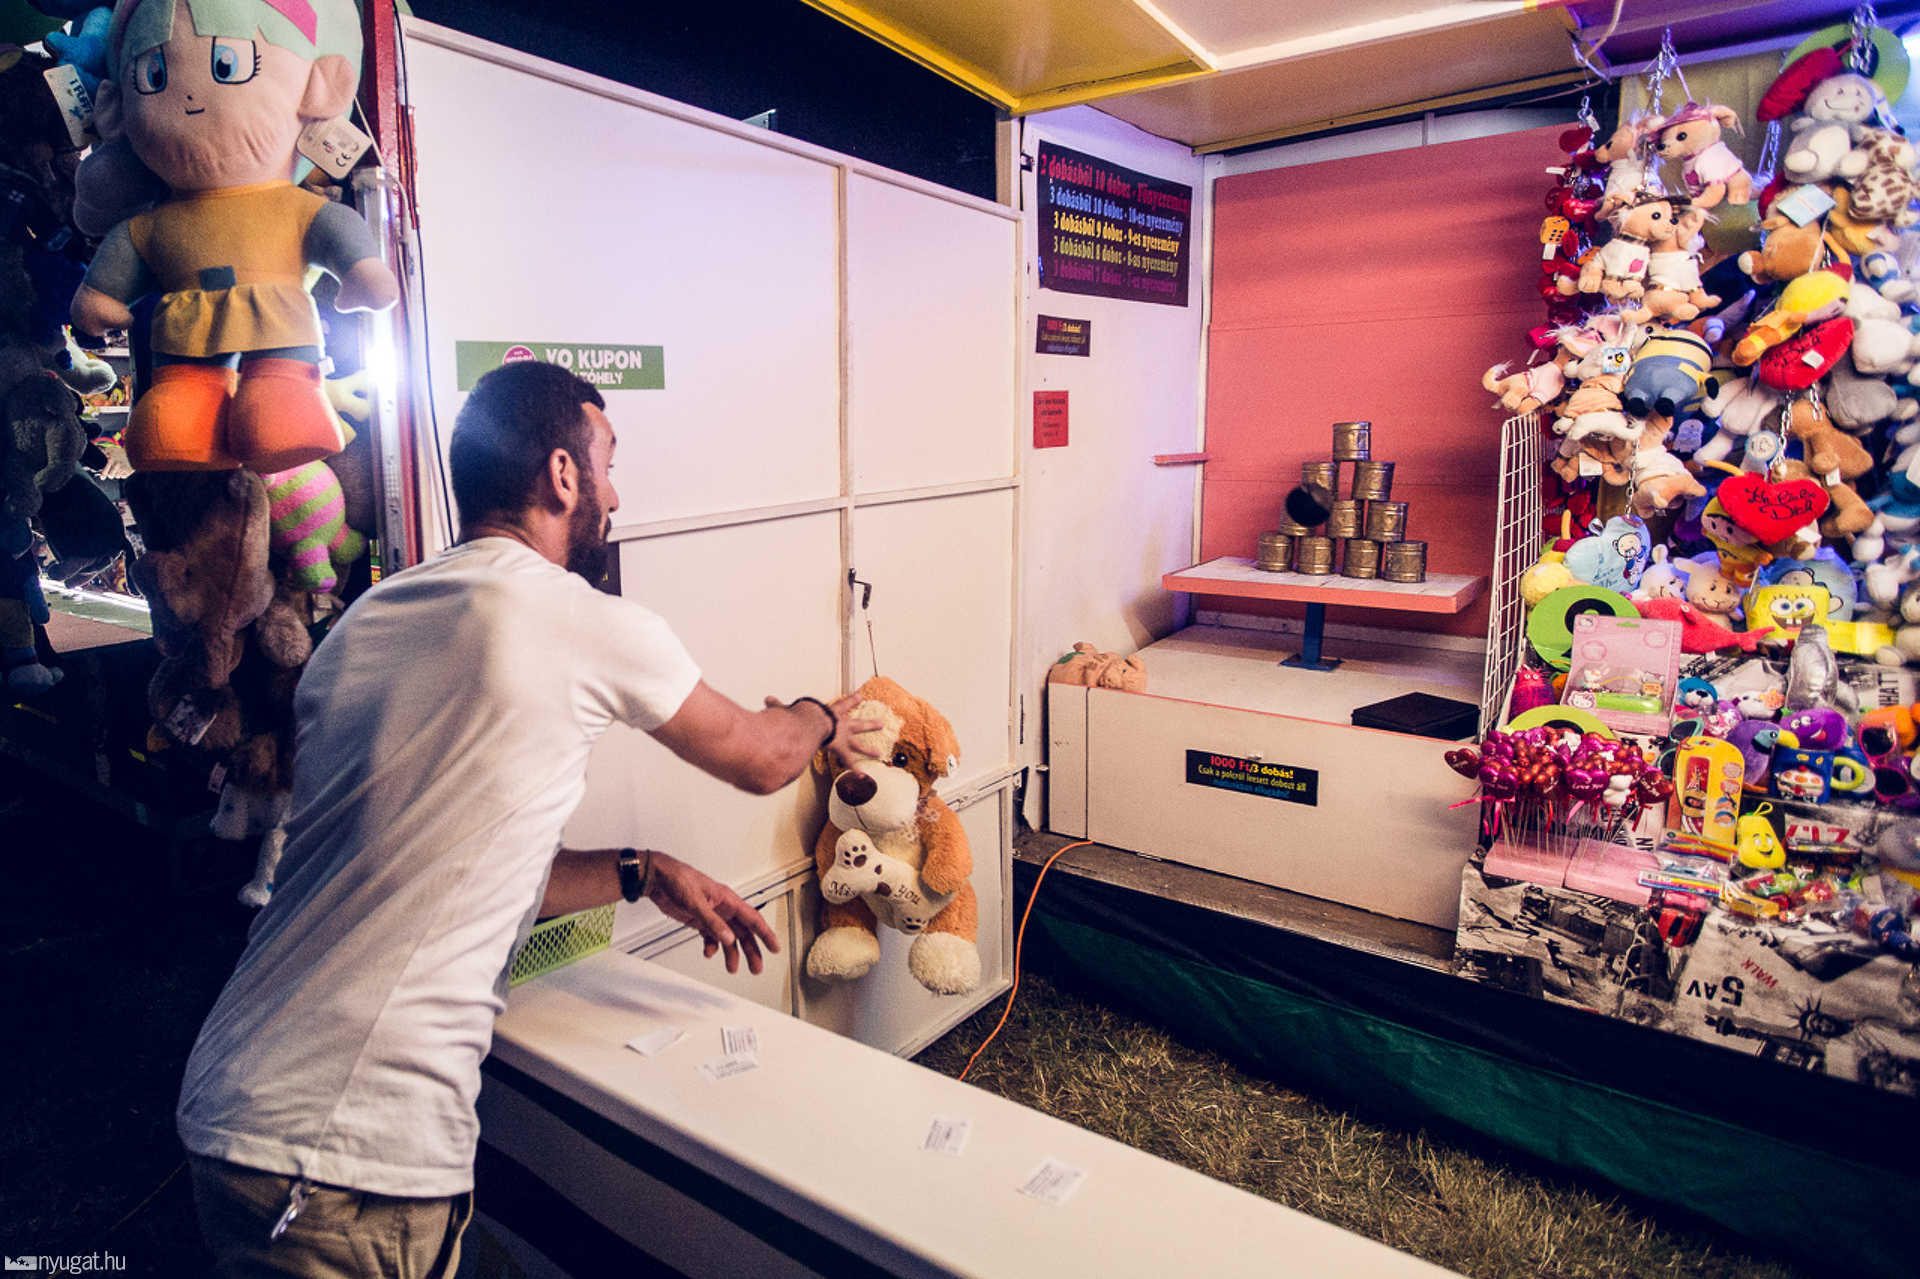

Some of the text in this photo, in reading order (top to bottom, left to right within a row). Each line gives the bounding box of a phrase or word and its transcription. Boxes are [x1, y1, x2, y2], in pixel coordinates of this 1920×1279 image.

[1049, 185, 1055, 204] 3
[1056, 186, 1092, 213] dobásból
[1093, 196, 1102, 215] 10
[1103, 199, 1123, 220] doboz
[1054, 210, 1059, 229] 3
[1060, 211, 1095, 237] dobásból
[1096, 220, 1102, 239] 9
[1102, 221, 1122, 243] doboz
[1142, 235, 1180, 258] nyeremény
[1053, 234, 1059, 253] 3
[1060, 235, 1094, 260] dobásból
[1102, 244, 1121, 265] doboz
[1142, 256, 1178, 278] nyeremény
[578, 349, 642, 369] KUPON
[1210, 755, 1236, 769] 1000
[1261, 765, 1294, 779] dobás!
[1686, 975, 1745, 1008] 5 AV
